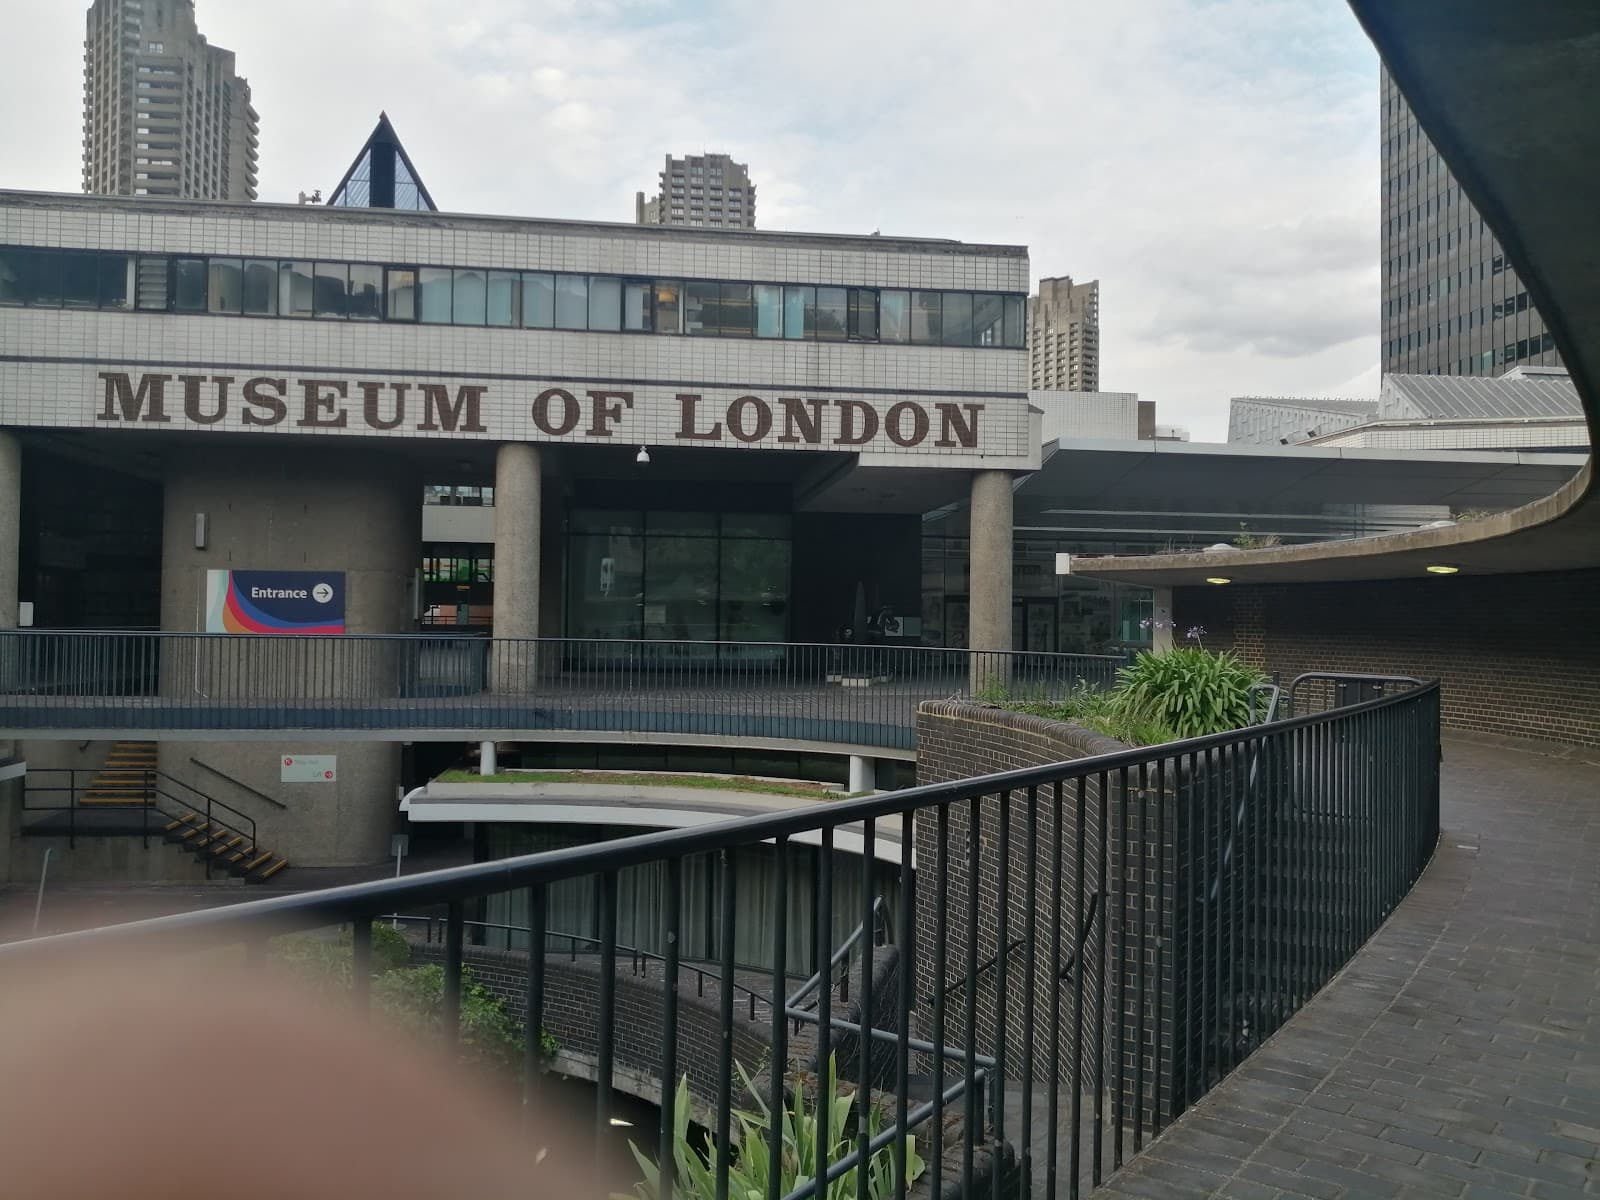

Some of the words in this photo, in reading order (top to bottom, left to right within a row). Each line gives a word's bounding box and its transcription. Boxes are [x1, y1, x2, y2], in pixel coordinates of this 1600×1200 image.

[96, 372, 488, 432] MUSEUM
[532, 387, 633, 437] OF
[675, 394, 985, 447] LONDON
[251, 587, 308, 599] Entrance
